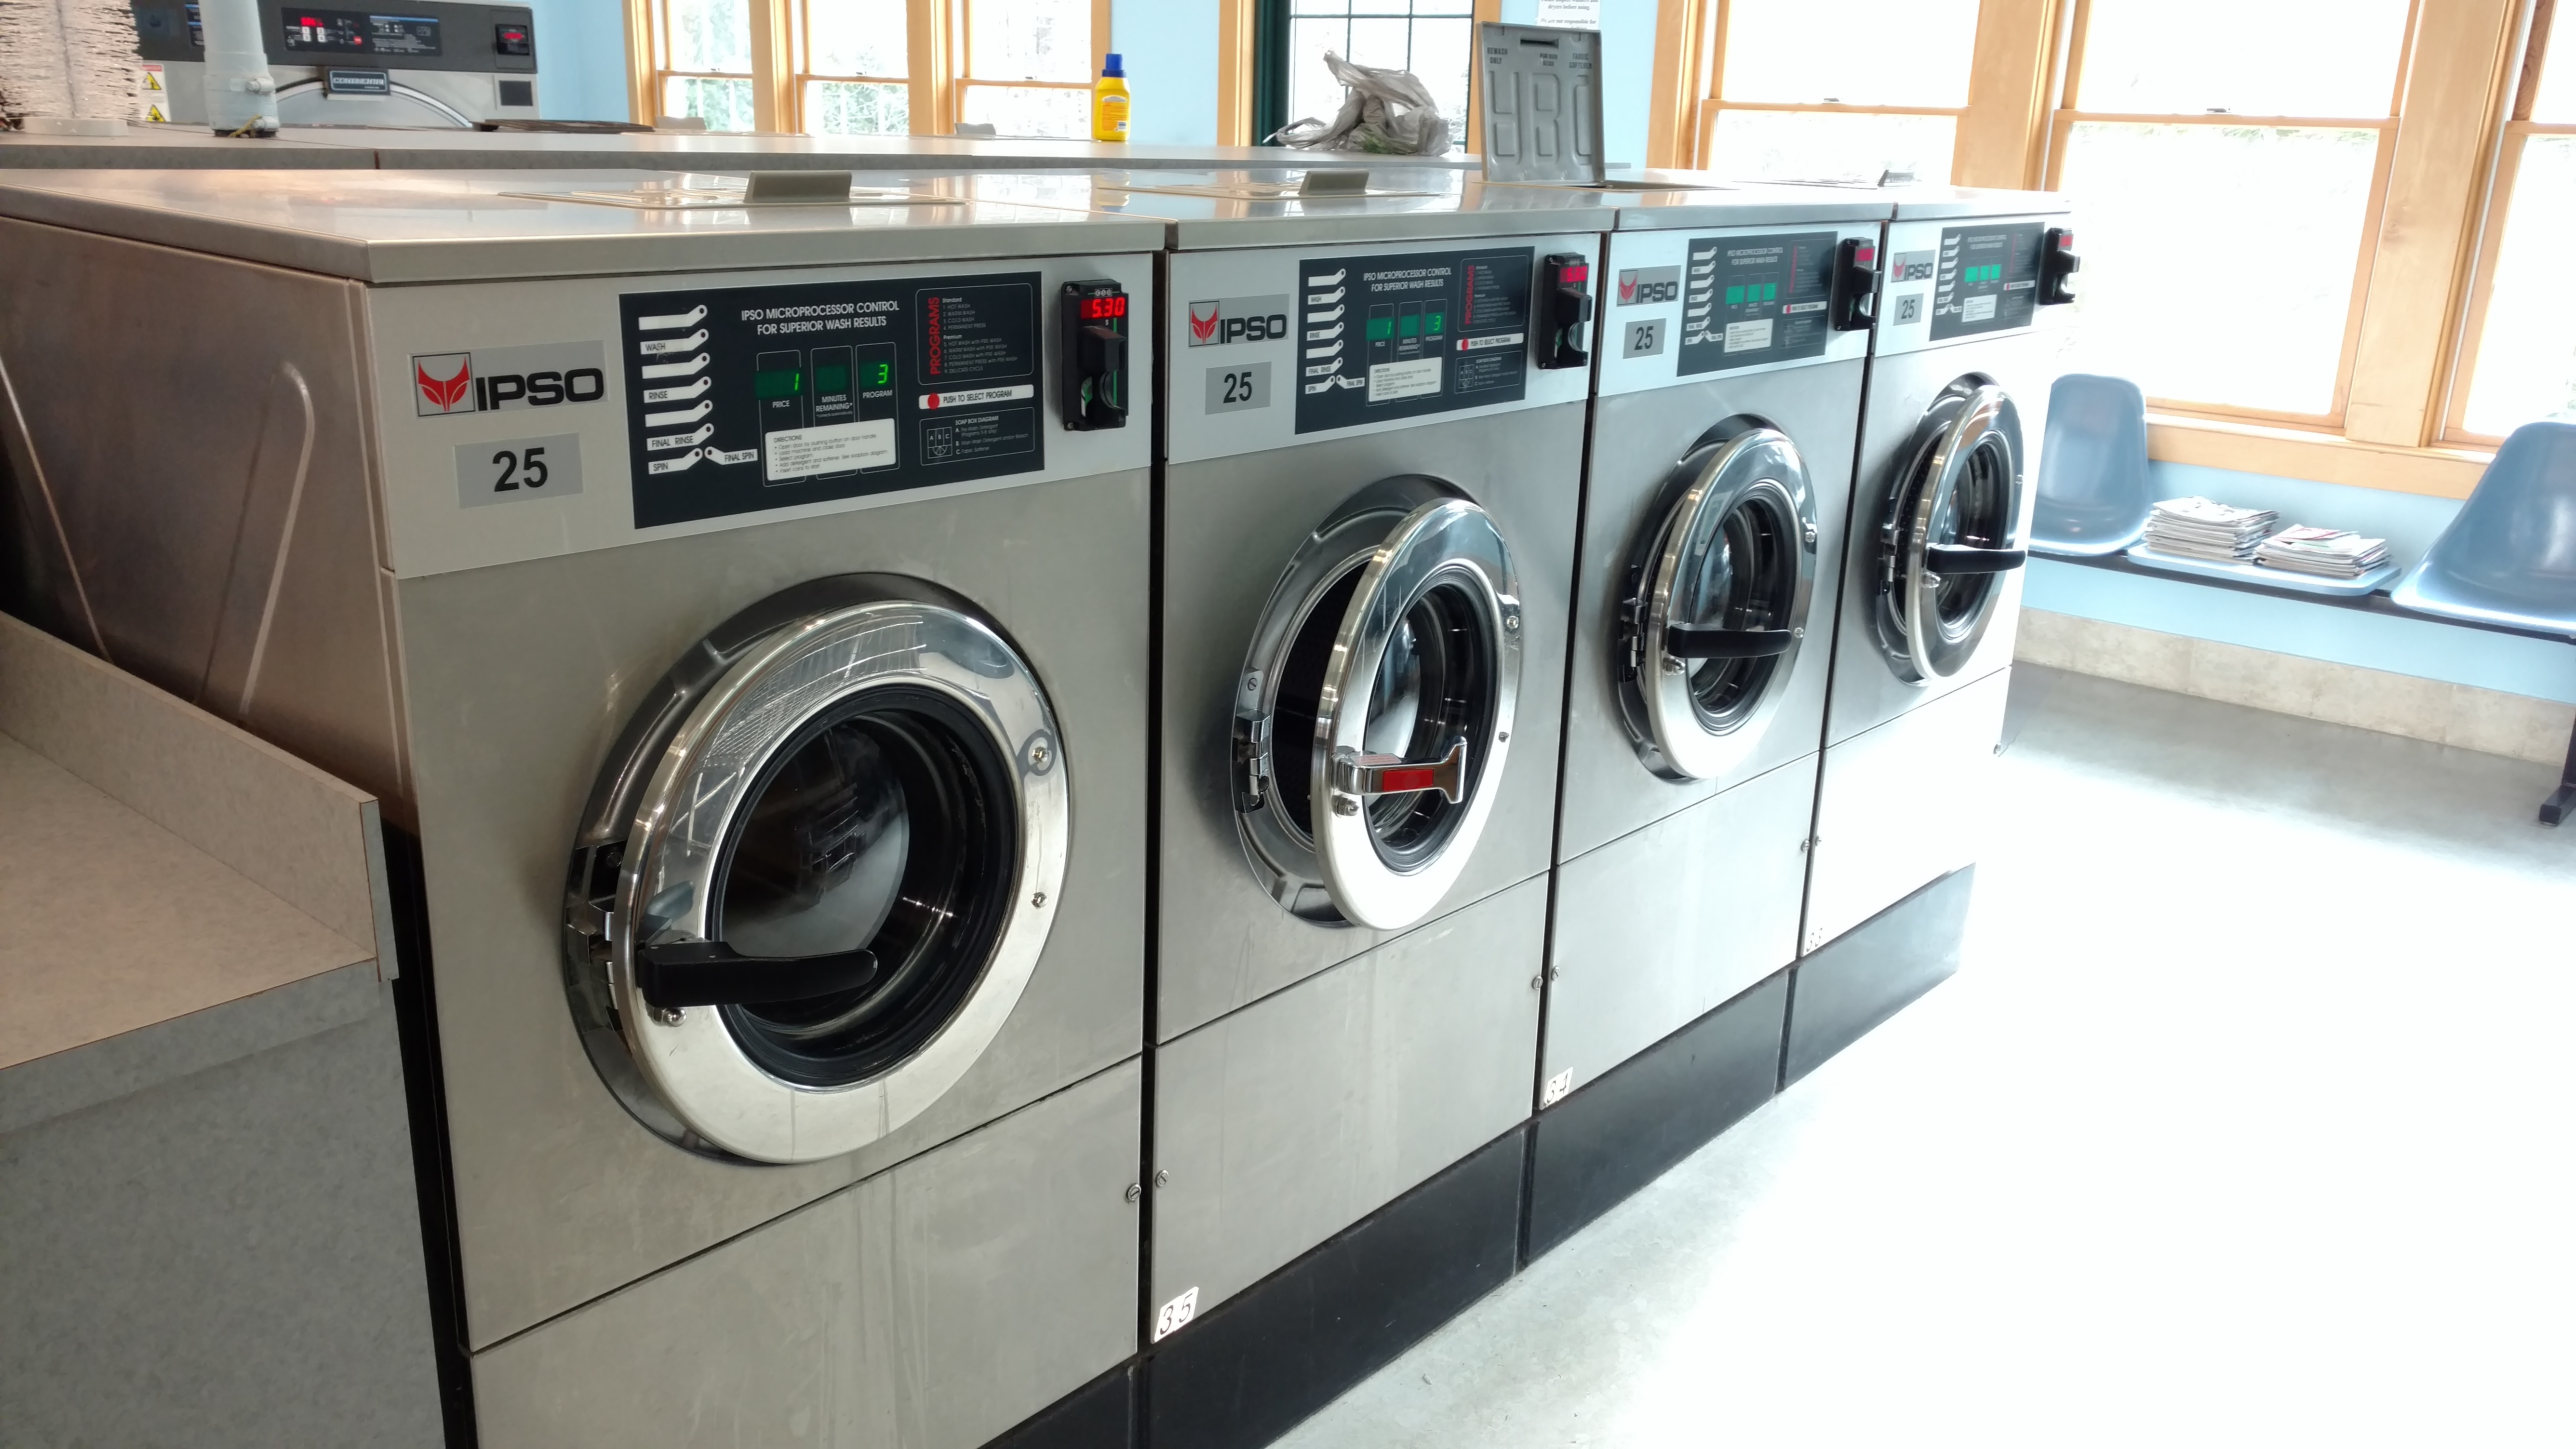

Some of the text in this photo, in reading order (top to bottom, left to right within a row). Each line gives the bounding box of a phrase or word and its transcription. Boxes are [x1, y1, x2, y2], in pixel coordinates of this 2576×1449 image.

[1377, 269, 1426, 281] MICROPROCESSOR
[1427, 267, 1451, 277] CONTROL
[1904, 262, 1933, 281] IPSO
[1371, 279, 1444, 292] FOR SUPERIOR WASH RESULTS
[1638, 281, 1678, 304] IPSO
[741, 301, 900, 321] IPSO MICROPROCESSOR CONTROL
[1092, 297, 1125, 317] 5.30
[1902, 299, 1915, 319] 25
[757, 316, 887, 335] FOR SUPERIOR WASH RESULTS
[1220, 314, 1287, 344] IPSO
[1434, 316, 1441, 331] 3
[928, 296, 941, 375] PROGRAMS
[1635, 326, 1654, 351] 25
[645, 343, 666, 351] WASH
[794, 373, 800, 391] 1
[877, 364, 889, 384] 3
[475, 367, 604, 411] IPSO
[648, 391, 668, 400] RINSE
[862, 389, 893, 399] PROGRAM
[943, 396, 956, 404] PUSH
[967, 392, 984, 402] SELECT
[986, 389, 1013, 400] PROGRAM
[1224, 371, 1252, 404] 25
[772, 400, 791, 409] PRICE
[821, 394, 847, 403] MINUTES
[652, 436, 694, 447] FINAL RINSE
[774, 434, 802, 443] DIRECTIONS
[724, 451, 755, 462] FINAL SPIN
[492, 447, 548, 492] 25
[653, 462, 669, 471] SPIN
[1160, 1292, 1193, 1335] 35
